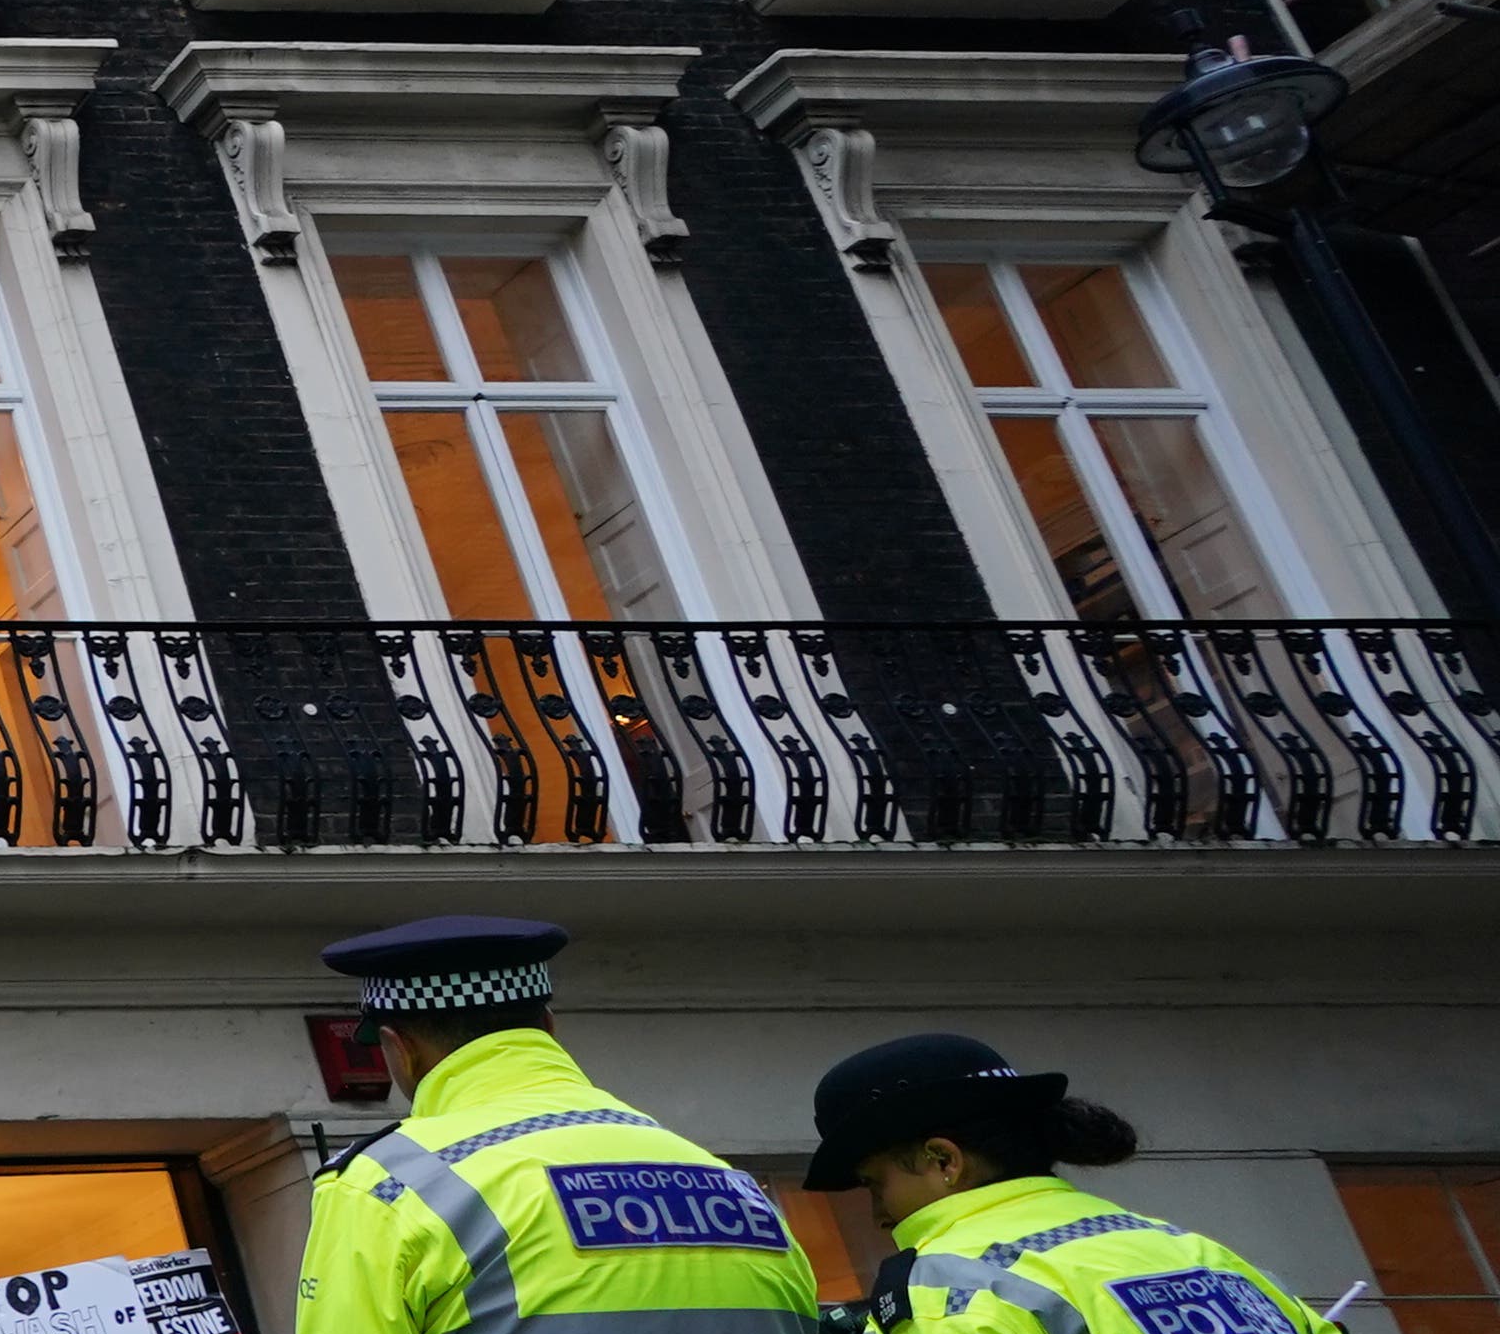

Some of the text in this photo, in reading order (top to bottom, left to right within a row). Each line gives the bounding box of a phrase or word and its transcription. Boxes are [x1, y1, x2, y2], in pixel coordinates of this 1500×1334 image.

[572, 1195, 777, 1240] POLICE
[155, 1257, 191, 1270] Worker
[136, 1272, 208, 1308] EEDOM
[115, 1306, 136, 1325] OF
[160, 1305, 179, 1317] for
